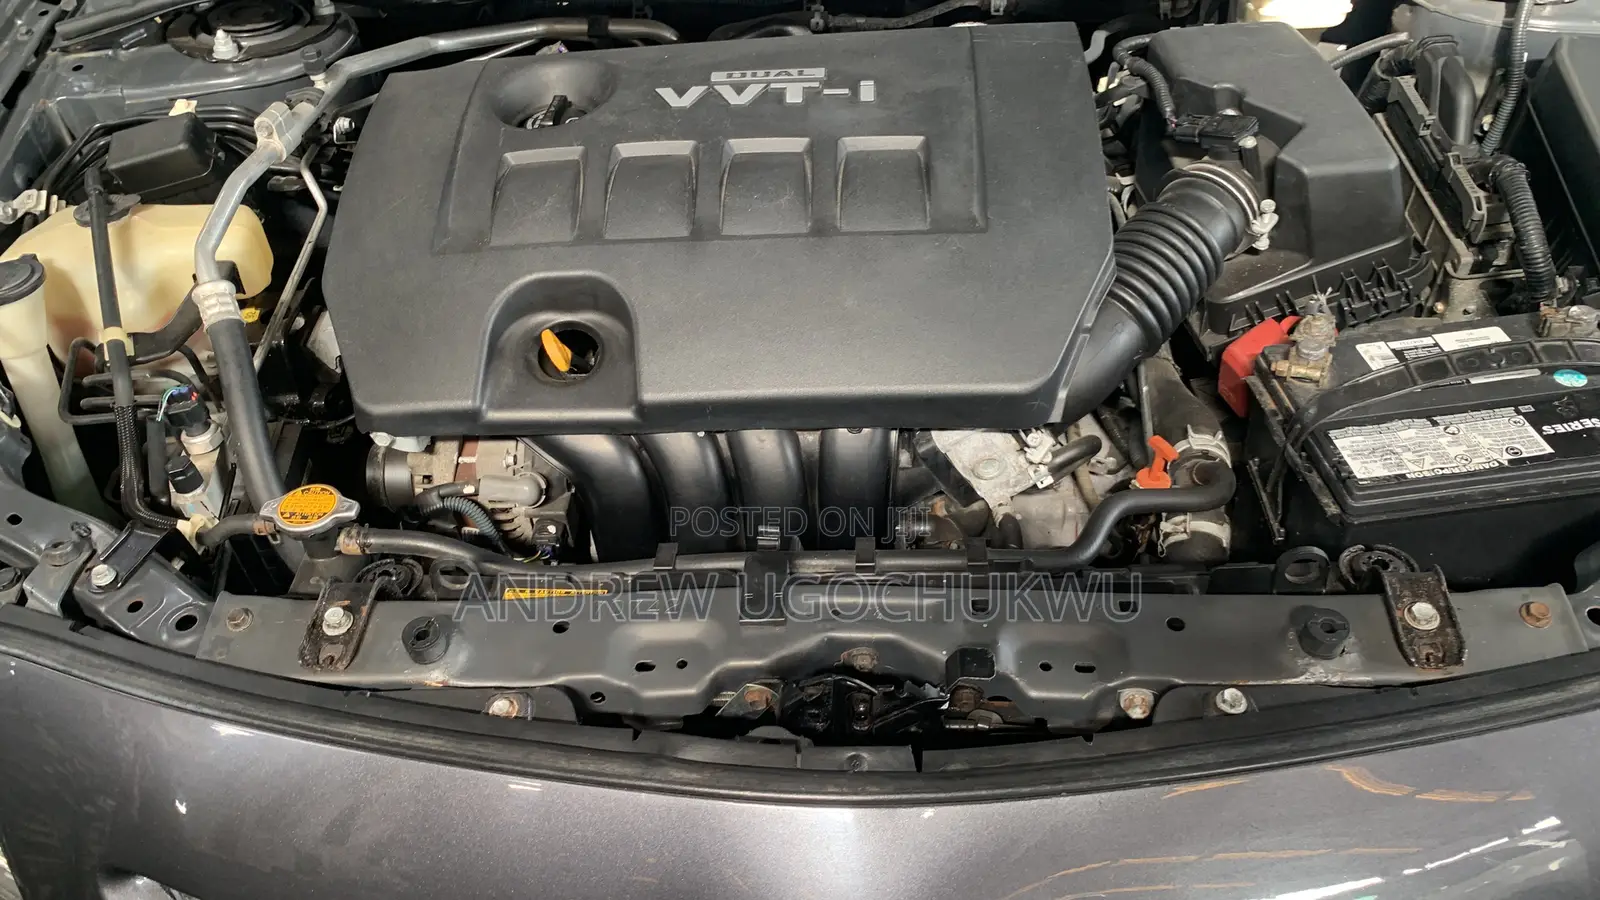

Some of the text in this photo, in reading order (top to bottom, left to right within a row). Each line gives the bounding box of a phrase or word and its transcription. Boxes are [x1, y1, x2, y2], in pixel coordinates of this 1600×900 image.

[726, 69, 815, 79] DUAL
[1541, 418, 1600, 435] SERIES
[1405, 460, 1499, 479] DANGER/POISON
